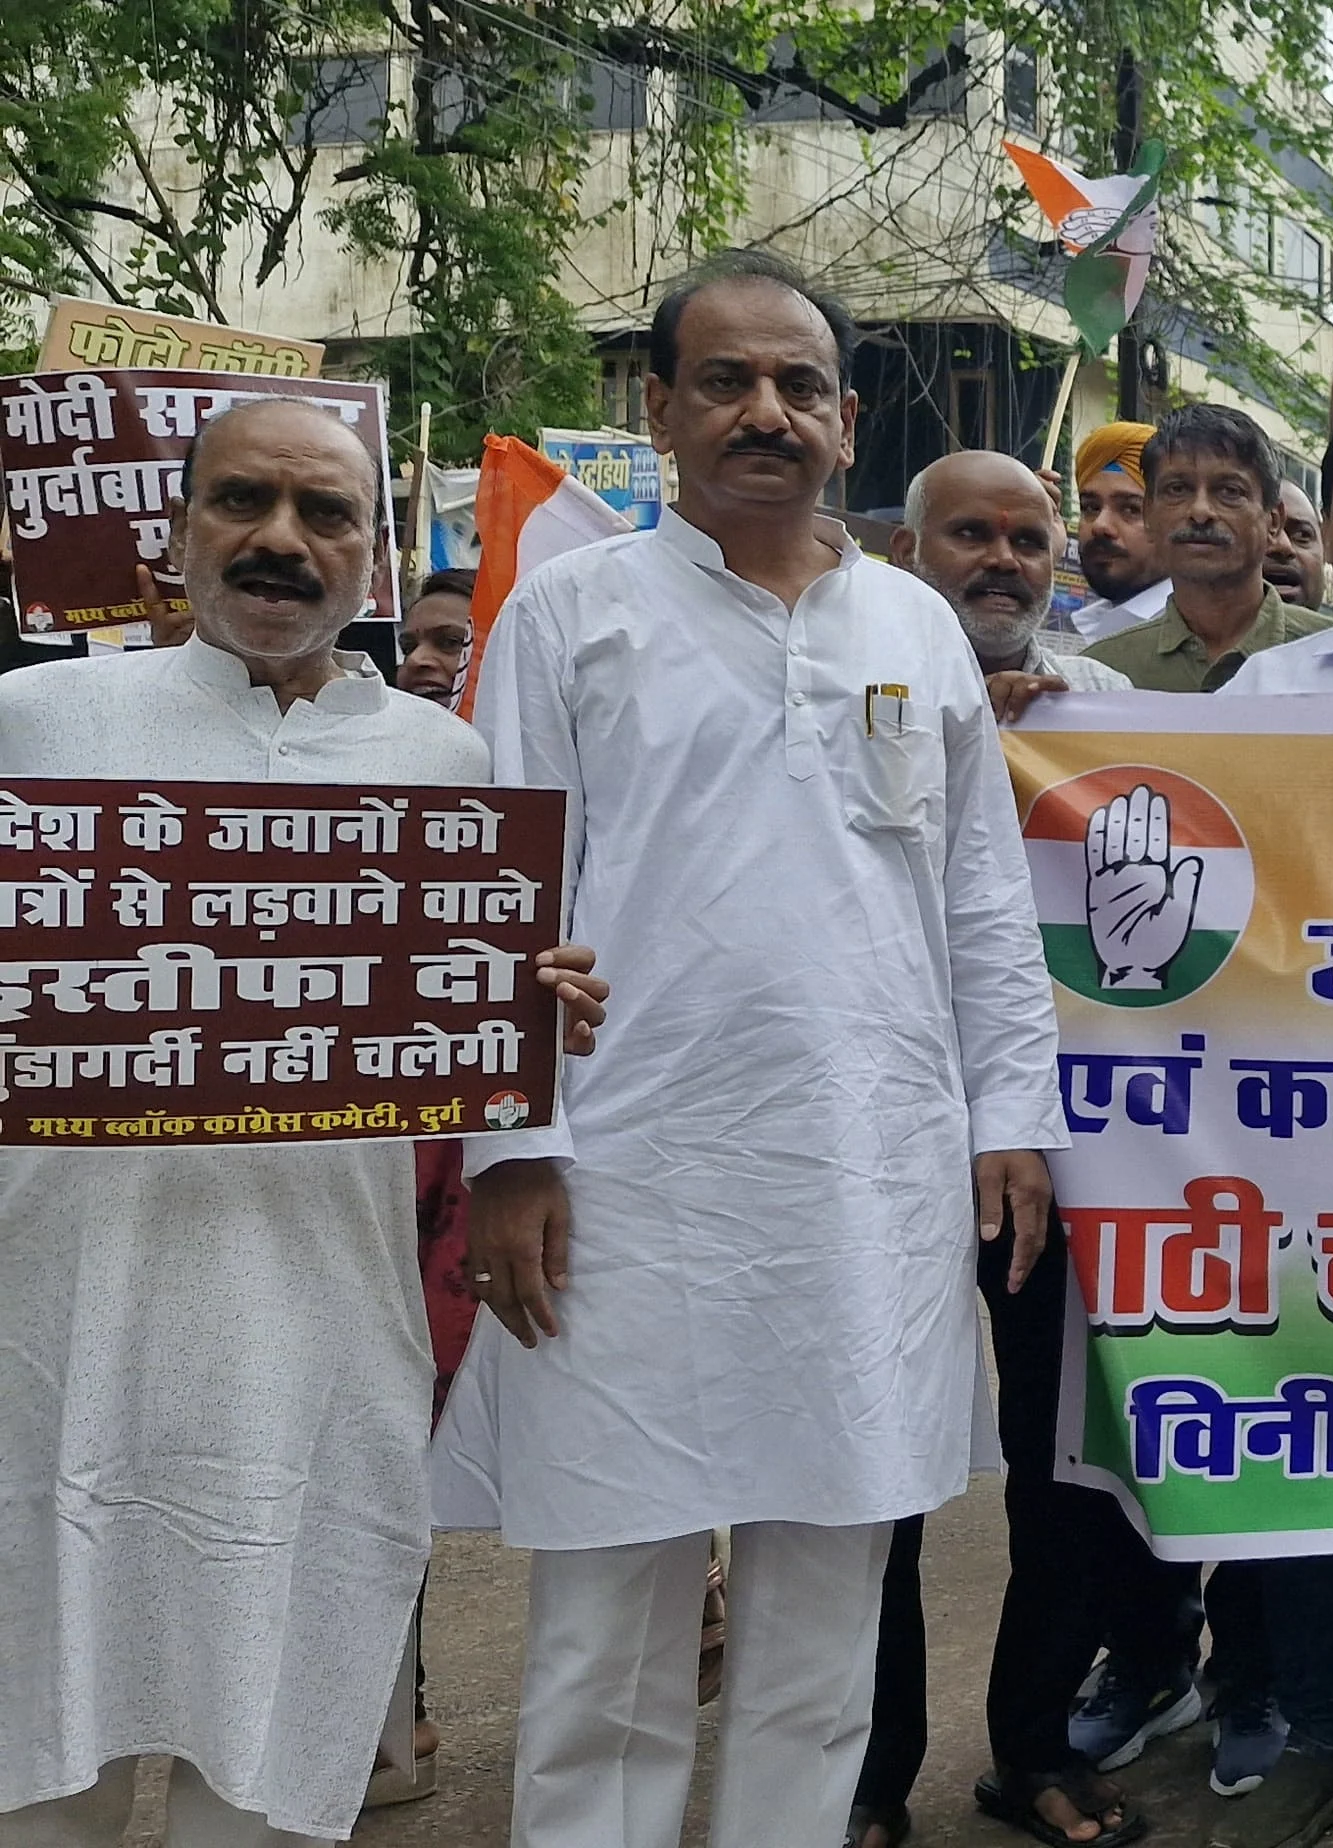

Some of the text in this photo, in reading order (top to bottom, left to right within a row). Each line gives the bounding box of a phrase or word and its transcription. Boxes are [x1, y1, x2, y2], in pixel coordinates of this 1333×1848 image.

[68, 315, 191, 369] फोटो
[1, 374, 117, 445] मोदी
[6, 446, 185, 541] मुर्दाबा
[106, 598, 147, 618] ब्लॉ
[0, 791, 506, 854] देश के जवानों को
[0, 867, 543, 941] ात्रों से लड़वाने वाले
[0, 937, 528, 1023] इस्तीफा दो
[220, 1025, 339, 1084] नहीं
[352, 1019, 526, 1079] चलेगी
[1057, 1033, 1206, 1135] एवं
[27, 1098, 465, 1138] मध्य ब्लॉक कांग्रेस कमेटी, दुर्ग
